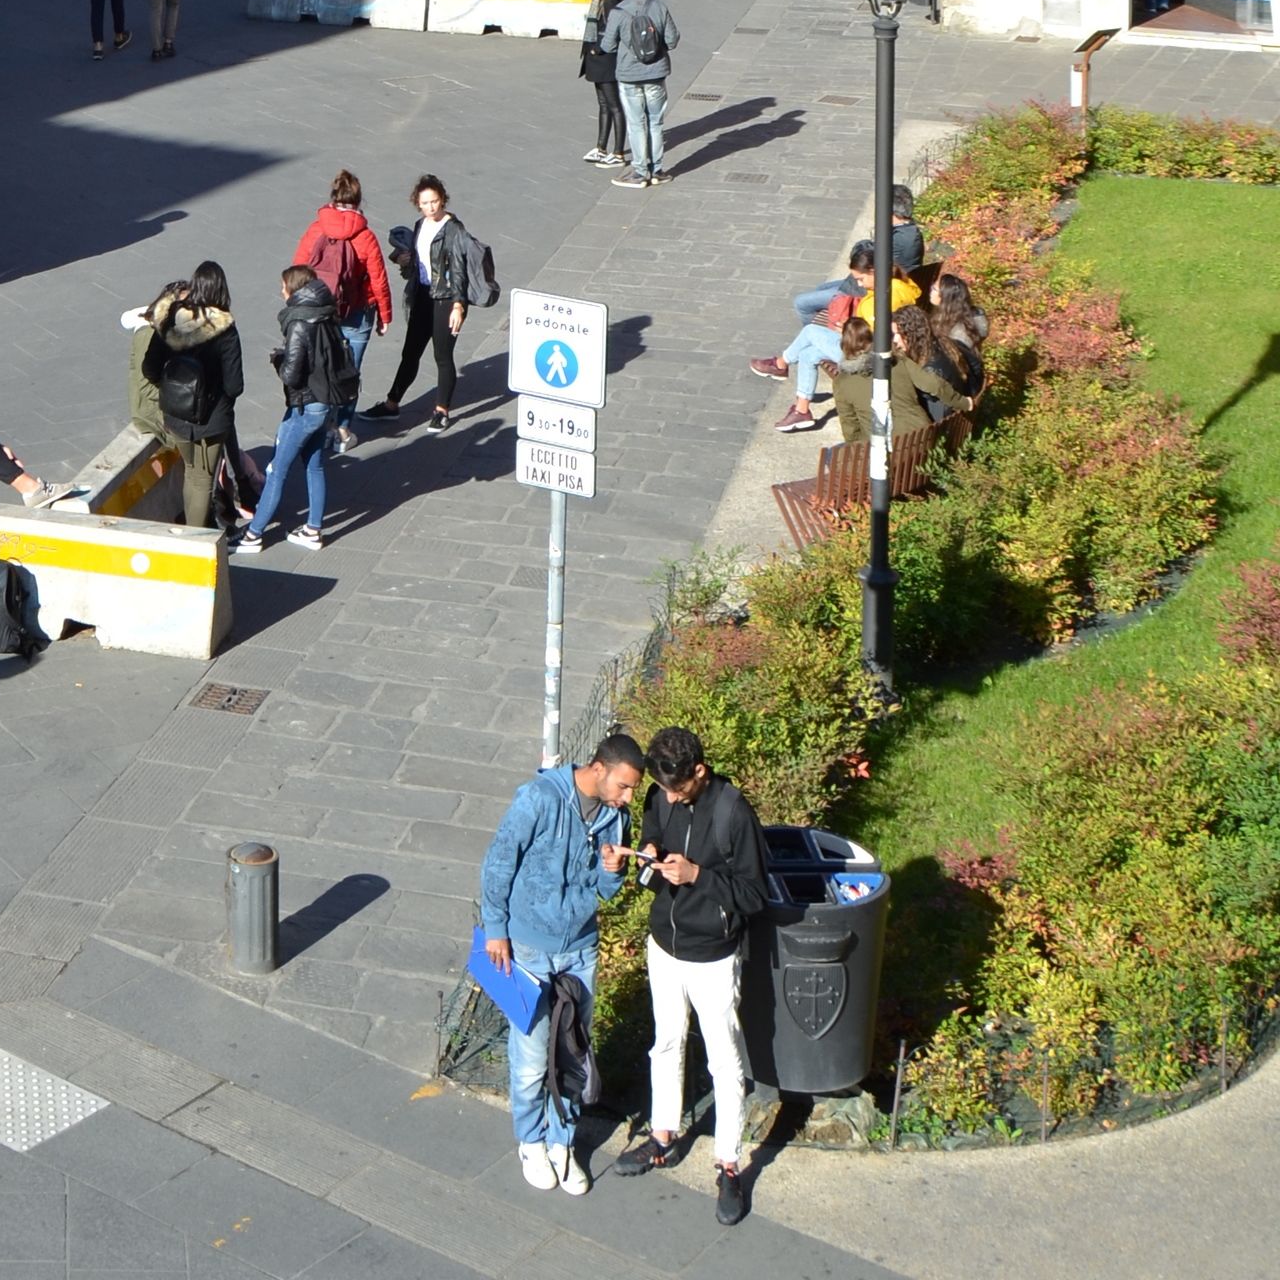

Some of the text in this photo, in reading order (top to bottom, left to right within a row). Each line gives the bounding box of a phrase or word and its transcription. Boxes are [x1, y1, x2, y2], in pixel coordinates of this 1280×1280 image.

[543, 302, 573, 316] area
[525, 316, 589, 336] pedonale
[531, 447, 577, 471] ECCETTO
[526, 466, 583, 491] TAXI PISA
